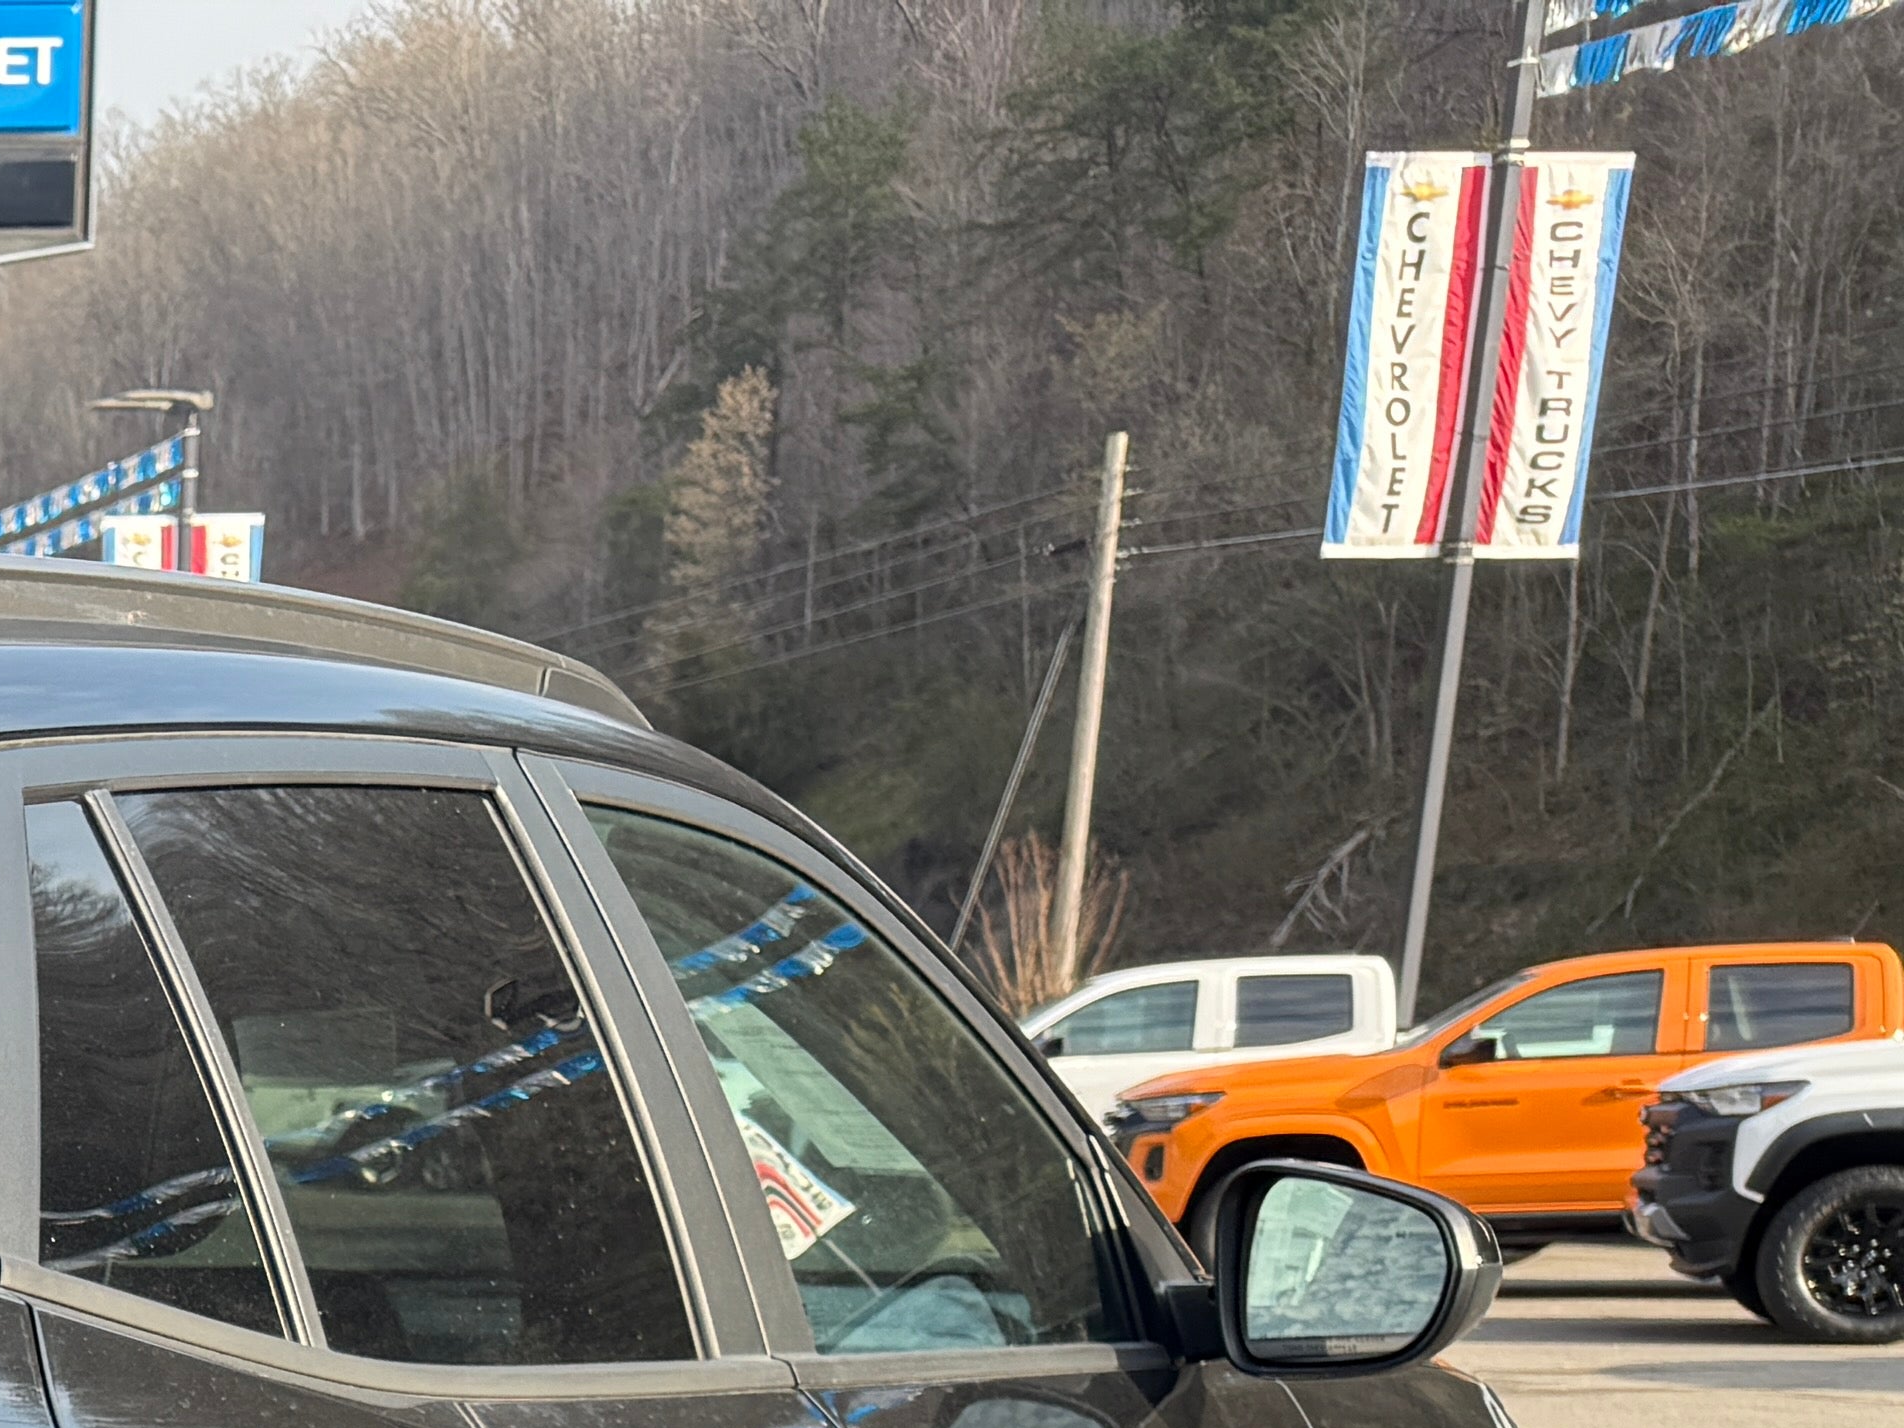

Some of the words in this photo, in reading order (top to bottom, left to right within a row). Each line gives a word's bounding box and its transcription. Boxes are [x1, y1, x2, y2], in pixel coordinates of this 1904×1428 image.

[1546, 221, 1584, 348] CHEVY
[1381, 212, 1431, 533] CHEVROLET
[1517, 371, 1574, 524] TRUCKS
